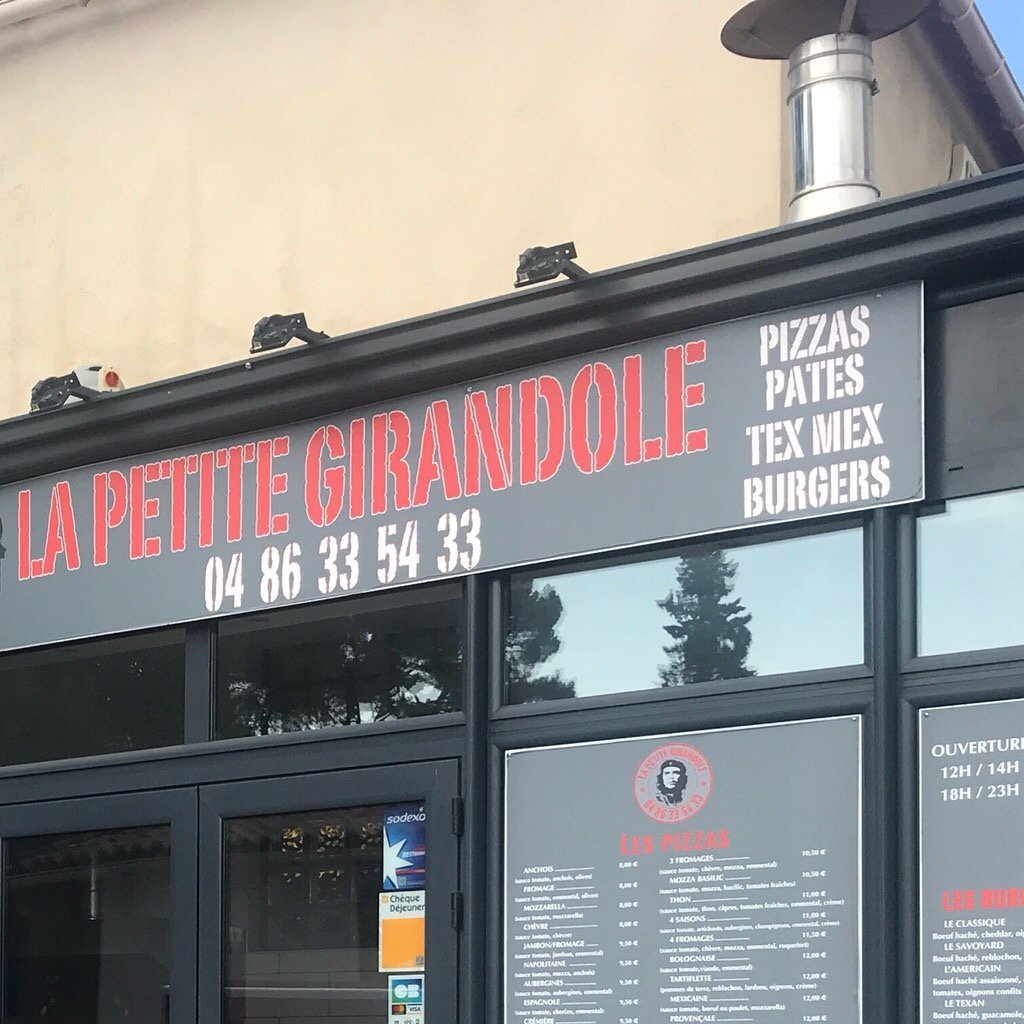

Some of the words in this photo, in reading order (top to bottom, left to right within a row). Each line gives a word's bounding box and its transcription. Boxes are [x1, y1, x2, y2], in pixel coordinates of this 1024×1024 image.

[759, 305, 871, 366] PIZZAS
[765, 354, 864, 410] PATES
[745, 420, 803, 468] TEX
[812, 404, 884, 455] MEX
[16, 480, 81, 581] LA
[92, 435, 289, 565] PETITE
[304, 339, 708, 527] GIRANDOLE
[742, 456, 891, 519] BURGERS
[204, 555, 245, 613] 04
[259, 546, 301, 603] 86
[317, 535, 360, 593] 33
[376, 521, 421, 584] 54
[436, 509, 483, 574] 33
[941, 765, 971, 779] 12H
[988, 761, 1019, 775] 14H
[941, 787, 971, 801] 18H
[987, 783, 1019, 799] 23H
[387, 813, 425, 824] sodexo
[620, 833, 653, 855] LES
[661, 828, 730, 852] PIZZAS
[669, 875, 695, 884] MOZZA
[697, 874, 724, 882] BASILIC
[390, 895, 420, 903] Chèque
[390, 904, 425, 912] Déjeuner
[524, 903, 566, 911] MOZZARELLA
[956, 918, 1006, 928] CLASSIQUE
[933, 932, 953, 940] Boeuf
[524, 941, 585, 949] JAMBON/FROMAGE
[956, 942, 1004, 950] SAVOYARD
[670, 955, 715, 963] BOLOGNAISE
[944, 965, 1001, 973] L'AMERICAIN
[956, 976, 977, 985] haché
[394, 984, 420, 999] CB
[965, 989, 994, 998] oignons
[670, 1015, 715, 1023] PROVENÇALE
